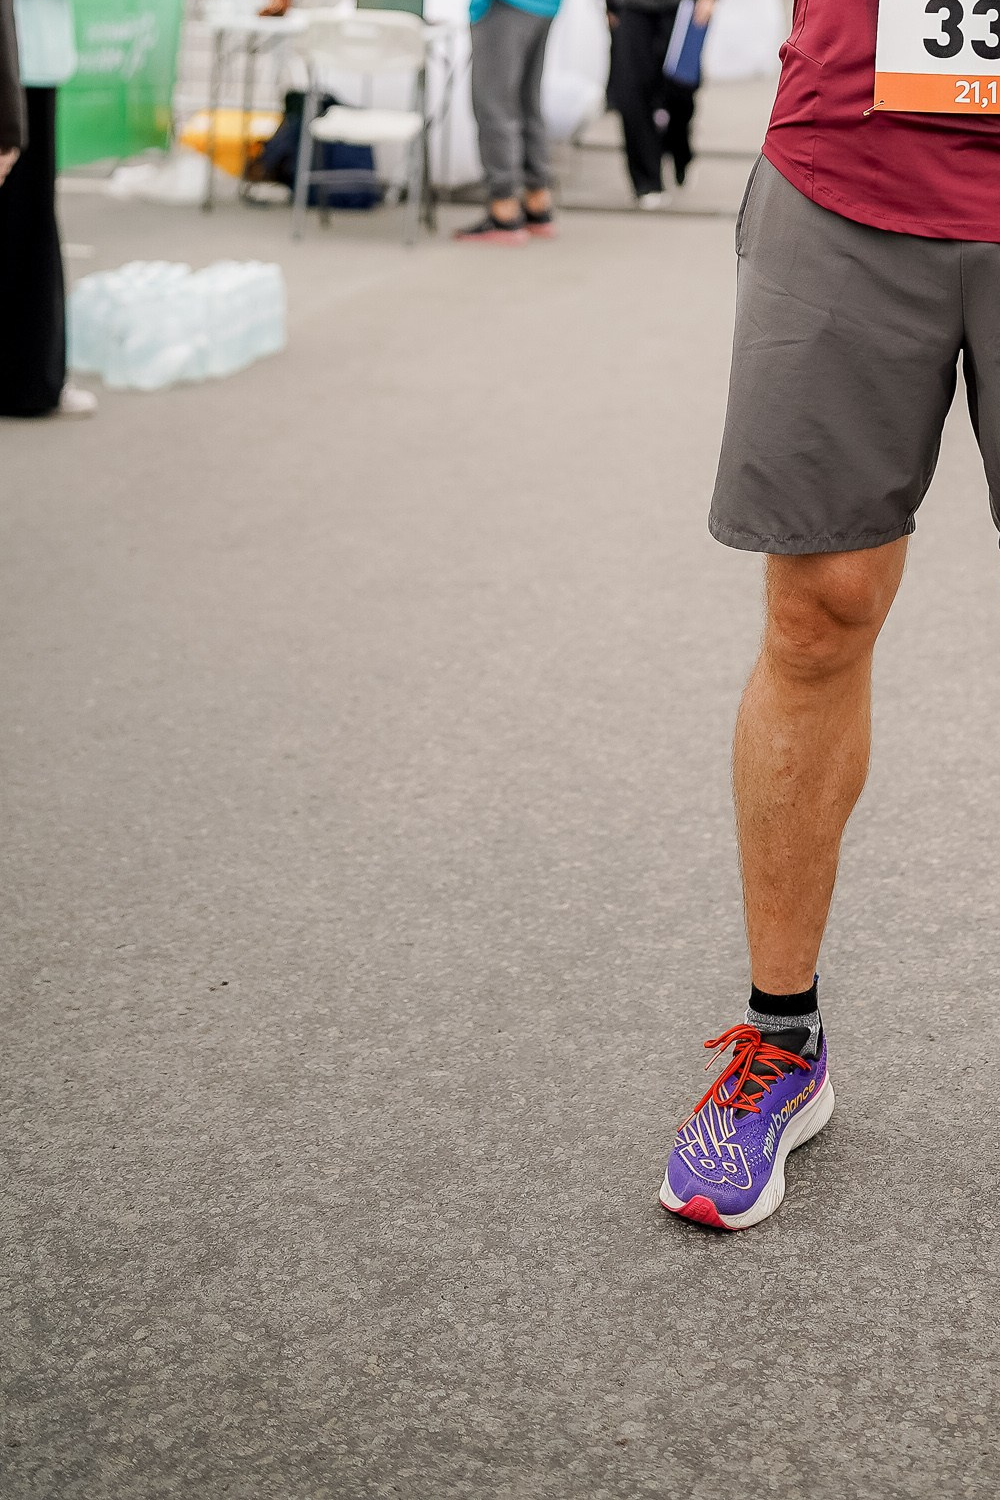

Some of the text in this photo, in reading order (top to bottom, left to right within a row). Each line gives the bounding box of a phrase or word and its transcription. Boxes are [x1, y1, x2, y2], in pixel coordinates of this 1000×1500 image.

[954, 80, 997, 108] 21,1
[762, 1079, 816, 1162] new balance
